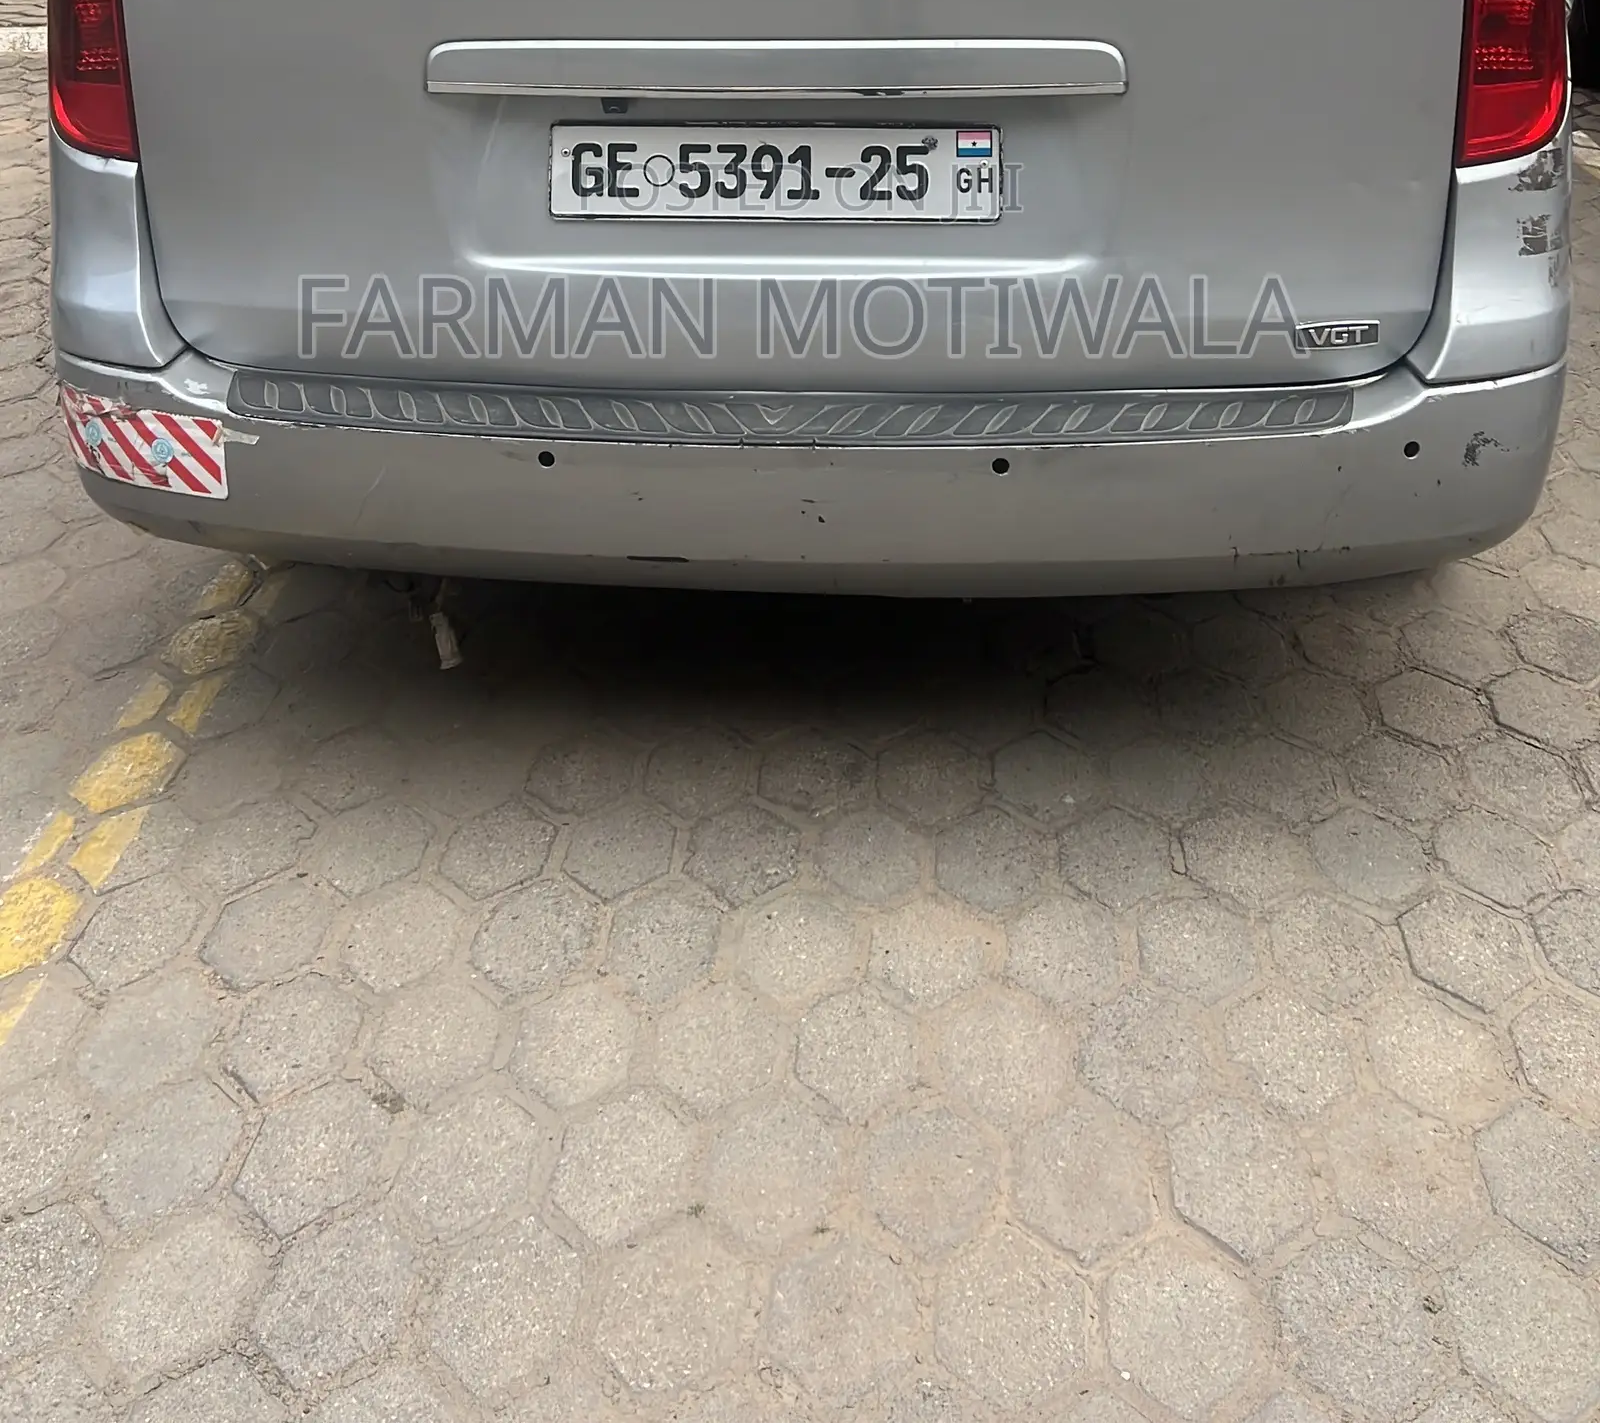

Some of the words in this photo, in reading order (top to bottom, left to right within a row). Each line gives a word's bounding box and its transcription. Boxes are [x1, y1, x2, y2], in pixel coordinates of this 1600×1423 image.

[571, 142, 640, 198] GE
[679, 142, 930, 200] 5391-25
[956, 166, 994, 195] GH
[1309, 325, 1369, 346] VGT
